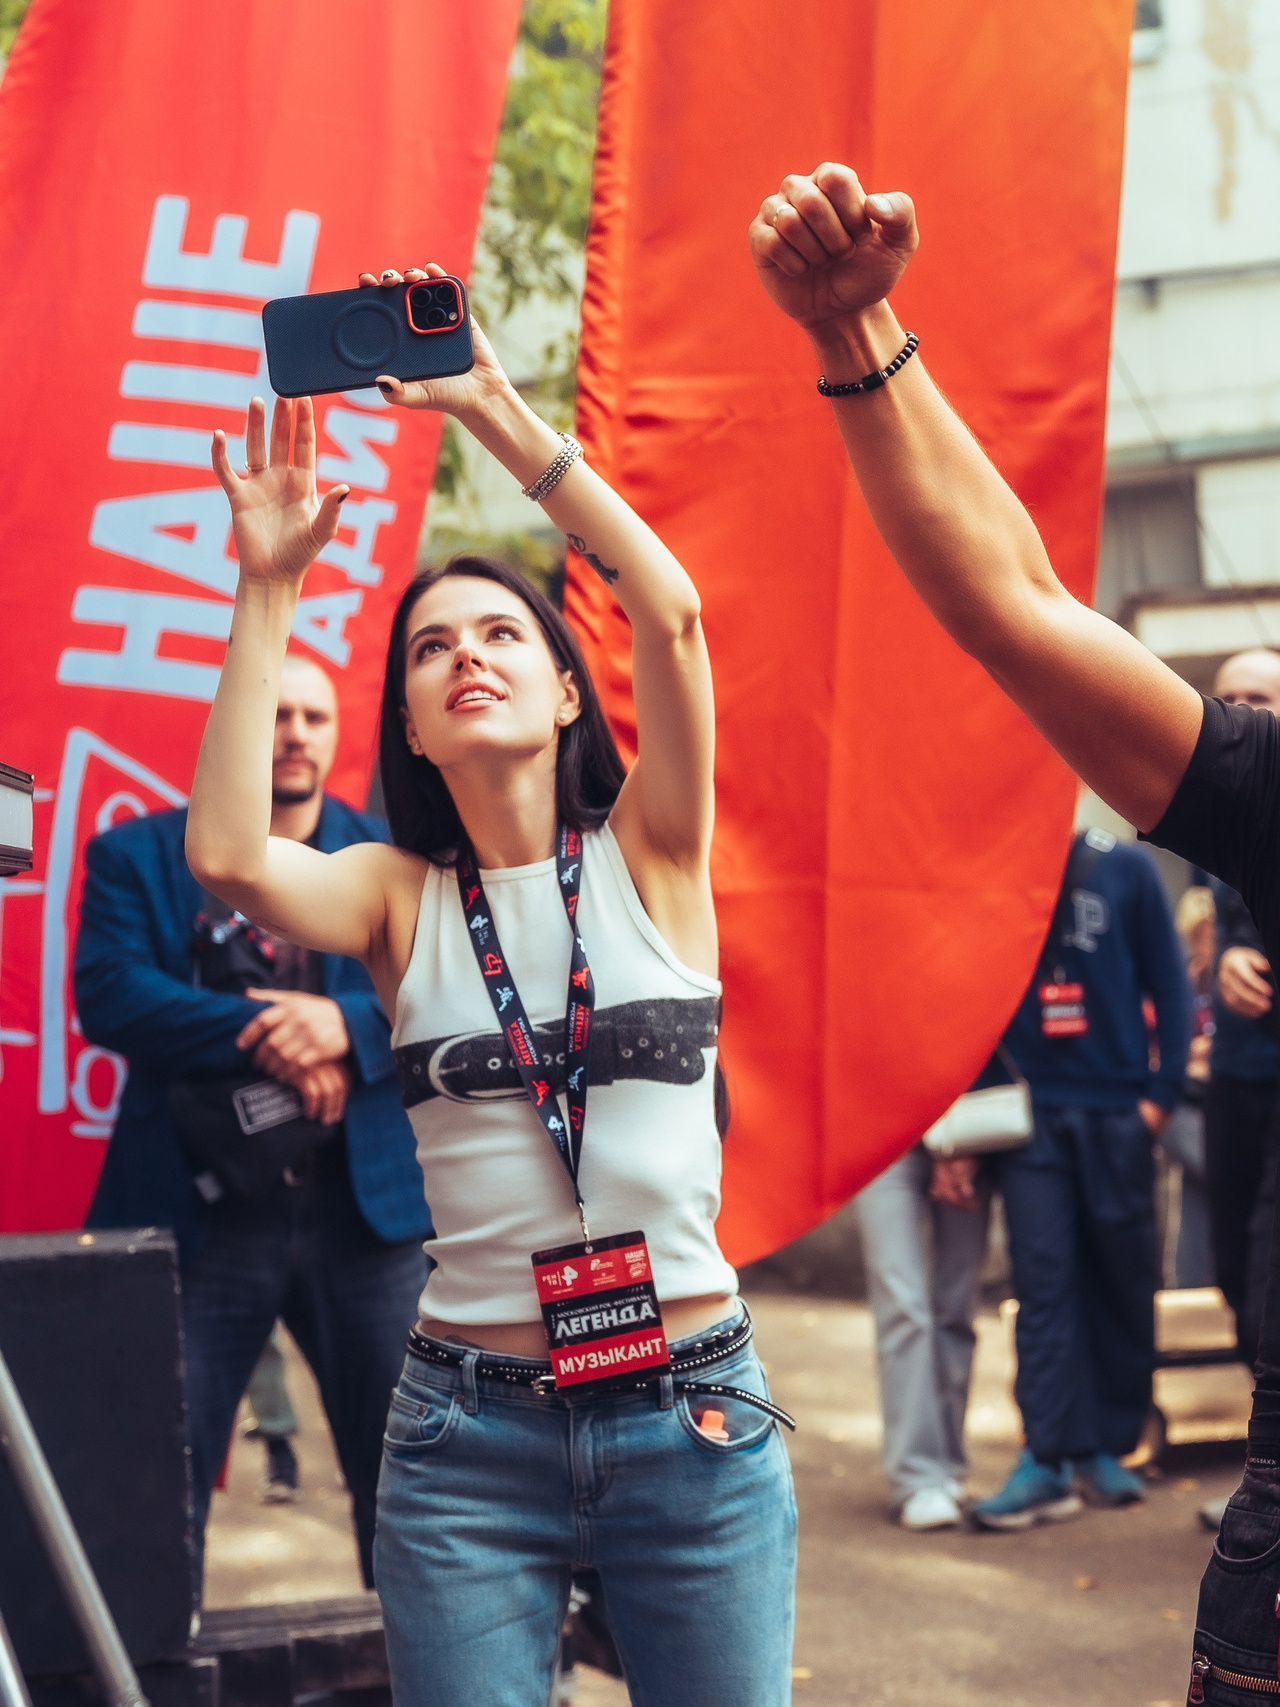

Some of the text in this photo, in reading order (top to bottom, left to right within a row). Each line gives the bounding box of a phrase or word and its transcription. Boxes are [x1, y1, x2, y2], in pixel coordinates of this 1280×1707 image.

[56, 194, 320, 703] НАШЕ
[290, 389, 399, 668] АДИ
[510, 1020, 533, 1066] ЛЕГЕНДА
[555, 1301, 657, 1340] ЛЕГЕНДА
[558, 1338, 663, 1375] МУЗЫКАНТ
